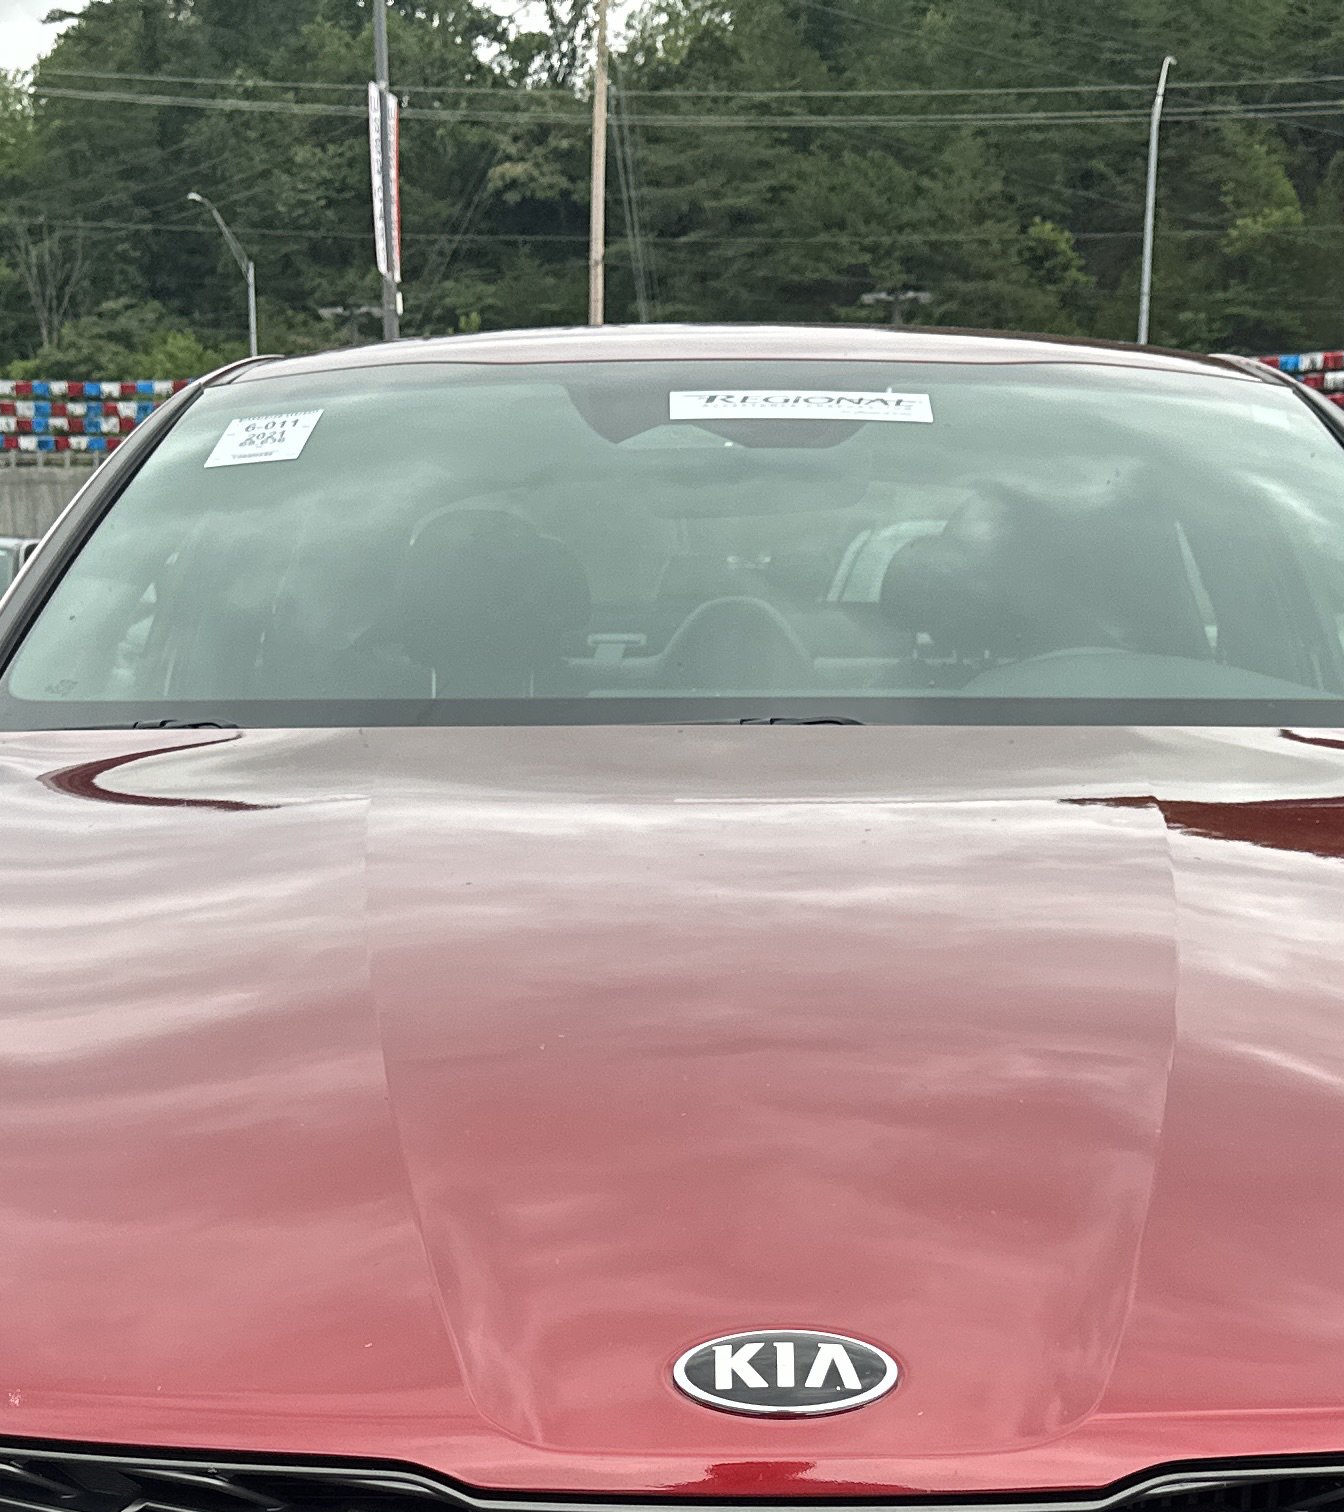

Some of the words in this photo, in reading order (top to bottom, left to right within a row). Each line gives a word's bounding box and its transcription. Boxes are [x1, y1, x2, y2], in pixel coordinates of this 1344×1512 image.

[702, 395, 918, 407] REGIONAL
[244, 418, 300, 432] 6-011
[244, 430, 287, 443] 2021
[712, 1342, 862, 1391] KIA
